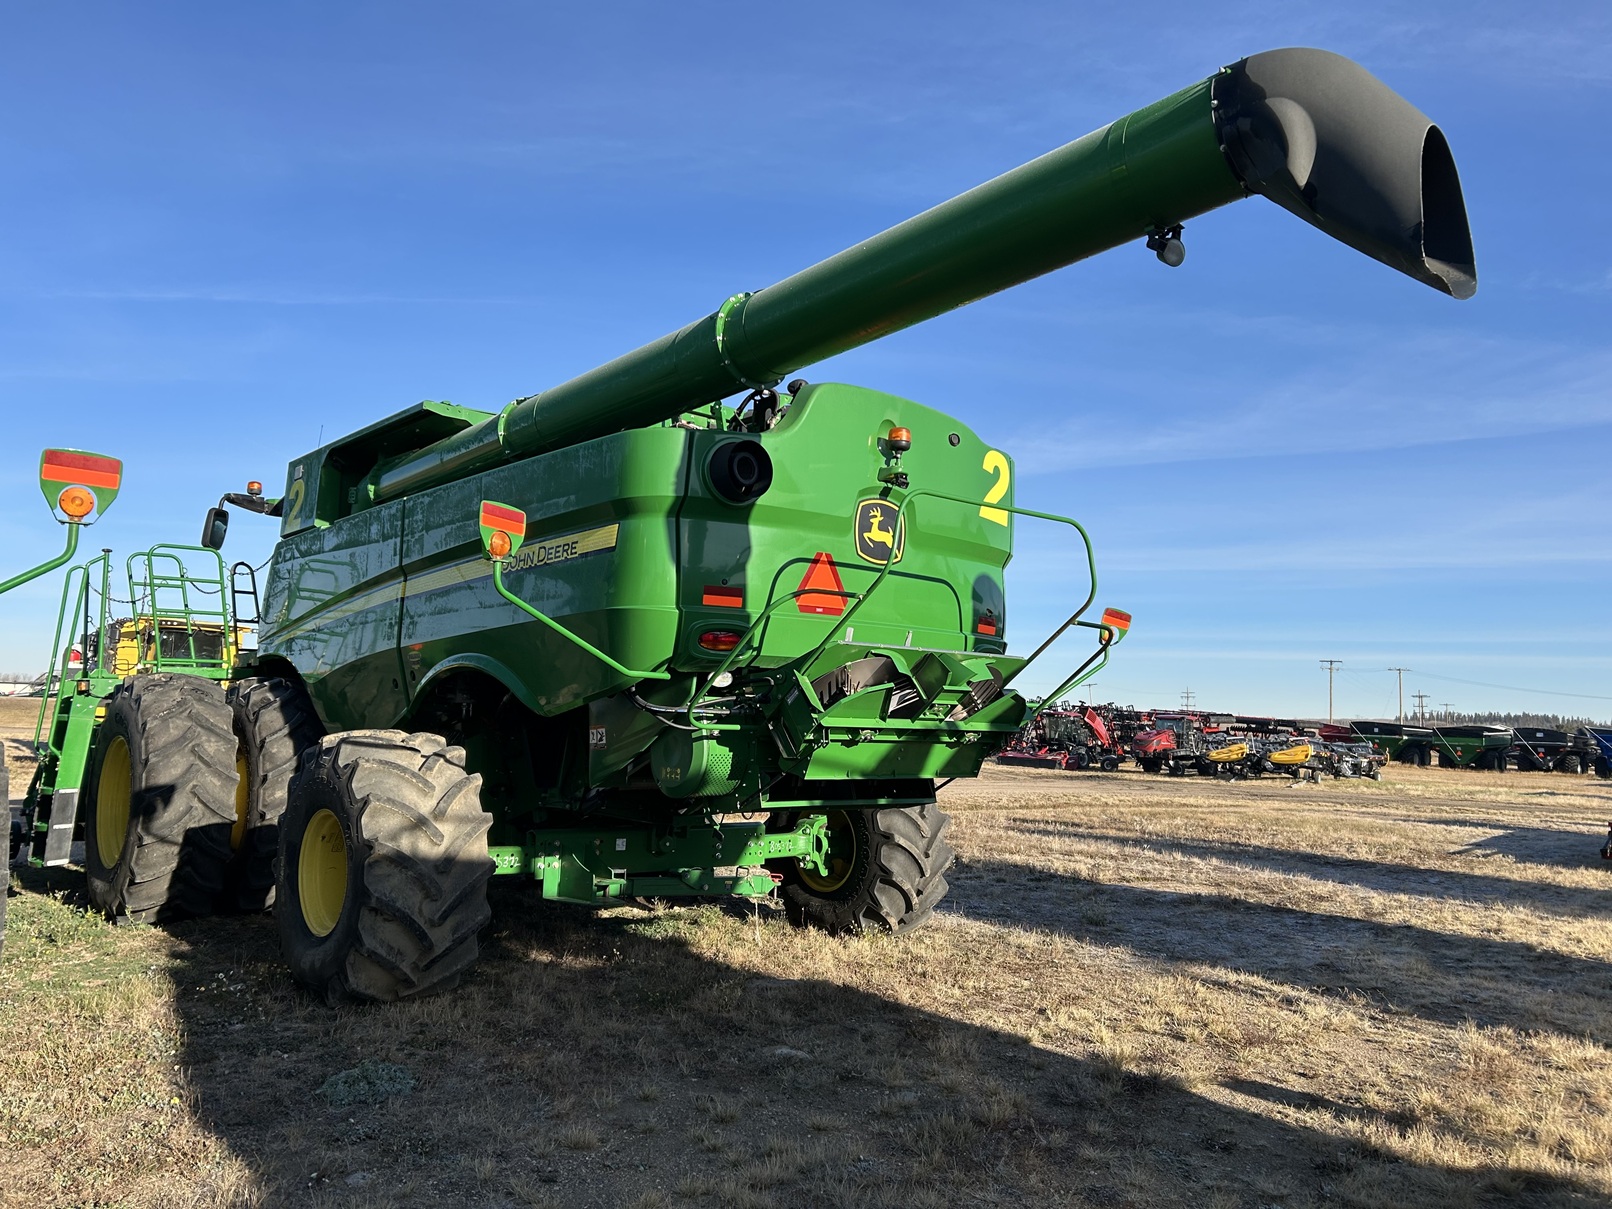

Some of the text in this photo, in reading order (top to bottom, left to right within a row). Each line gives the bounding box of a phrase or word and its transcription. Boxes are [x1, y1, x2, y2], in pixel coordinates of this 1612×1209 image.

[285, 479, 304, 533] 2
[979, 449, 1010, 527] 2
[536, 541, 578, 563] DEERE
[490, 855, 521, 868] 5372
